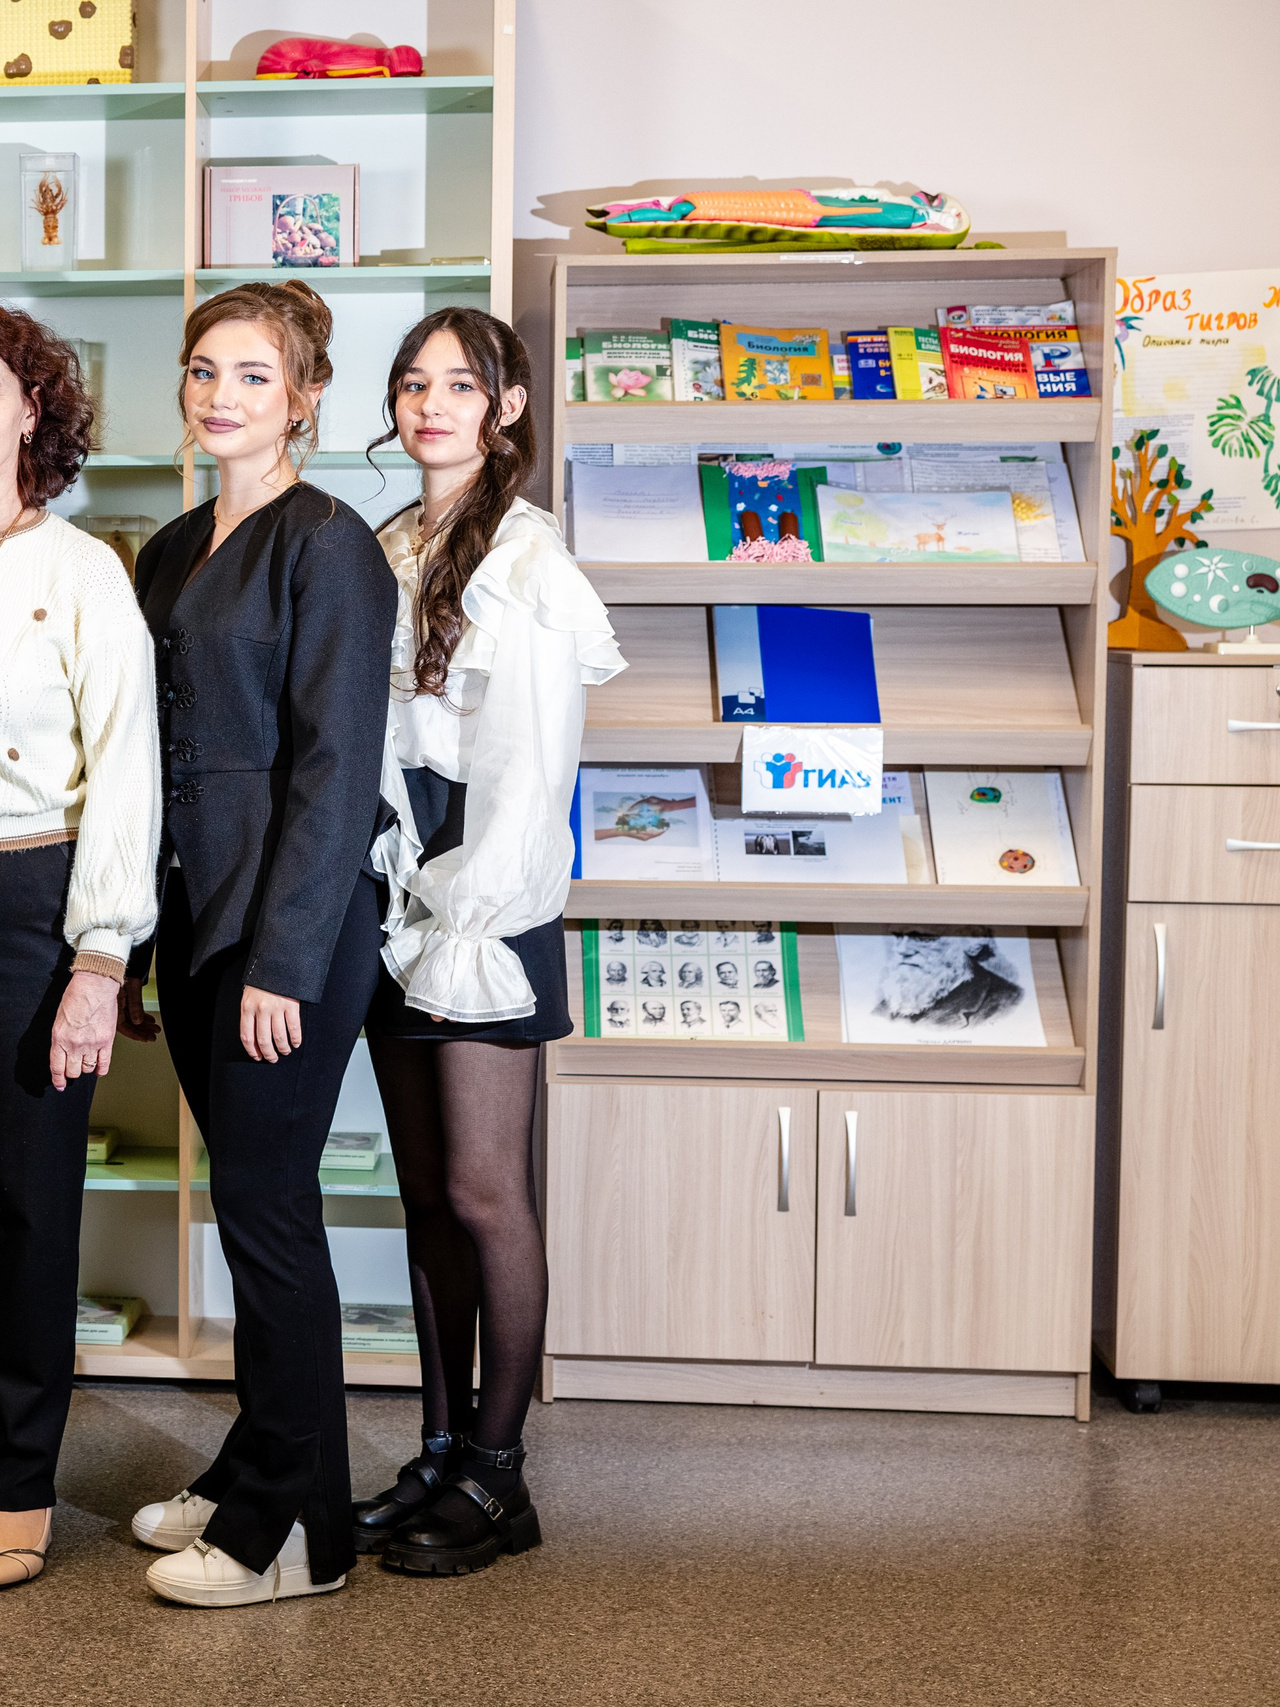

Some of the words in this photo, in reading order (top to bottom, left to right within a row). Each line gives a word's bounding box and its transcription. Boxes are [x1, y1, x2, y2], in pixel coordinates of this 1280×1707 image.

[229, 194, 263, 202] ГРИБОВ
[1115, 277, 1192, 315] Образ
[747, 341, 809, 353] Биология
[1142, 335, 1192, 348] Описание
[950, 344, 1024, 362] БИОЛОГИЯ
[1036, 372, 1077, 382] ВЫЕ
[1037, 382, 1077, 393] НИЯ
[732, 707, 755, 715] A4
